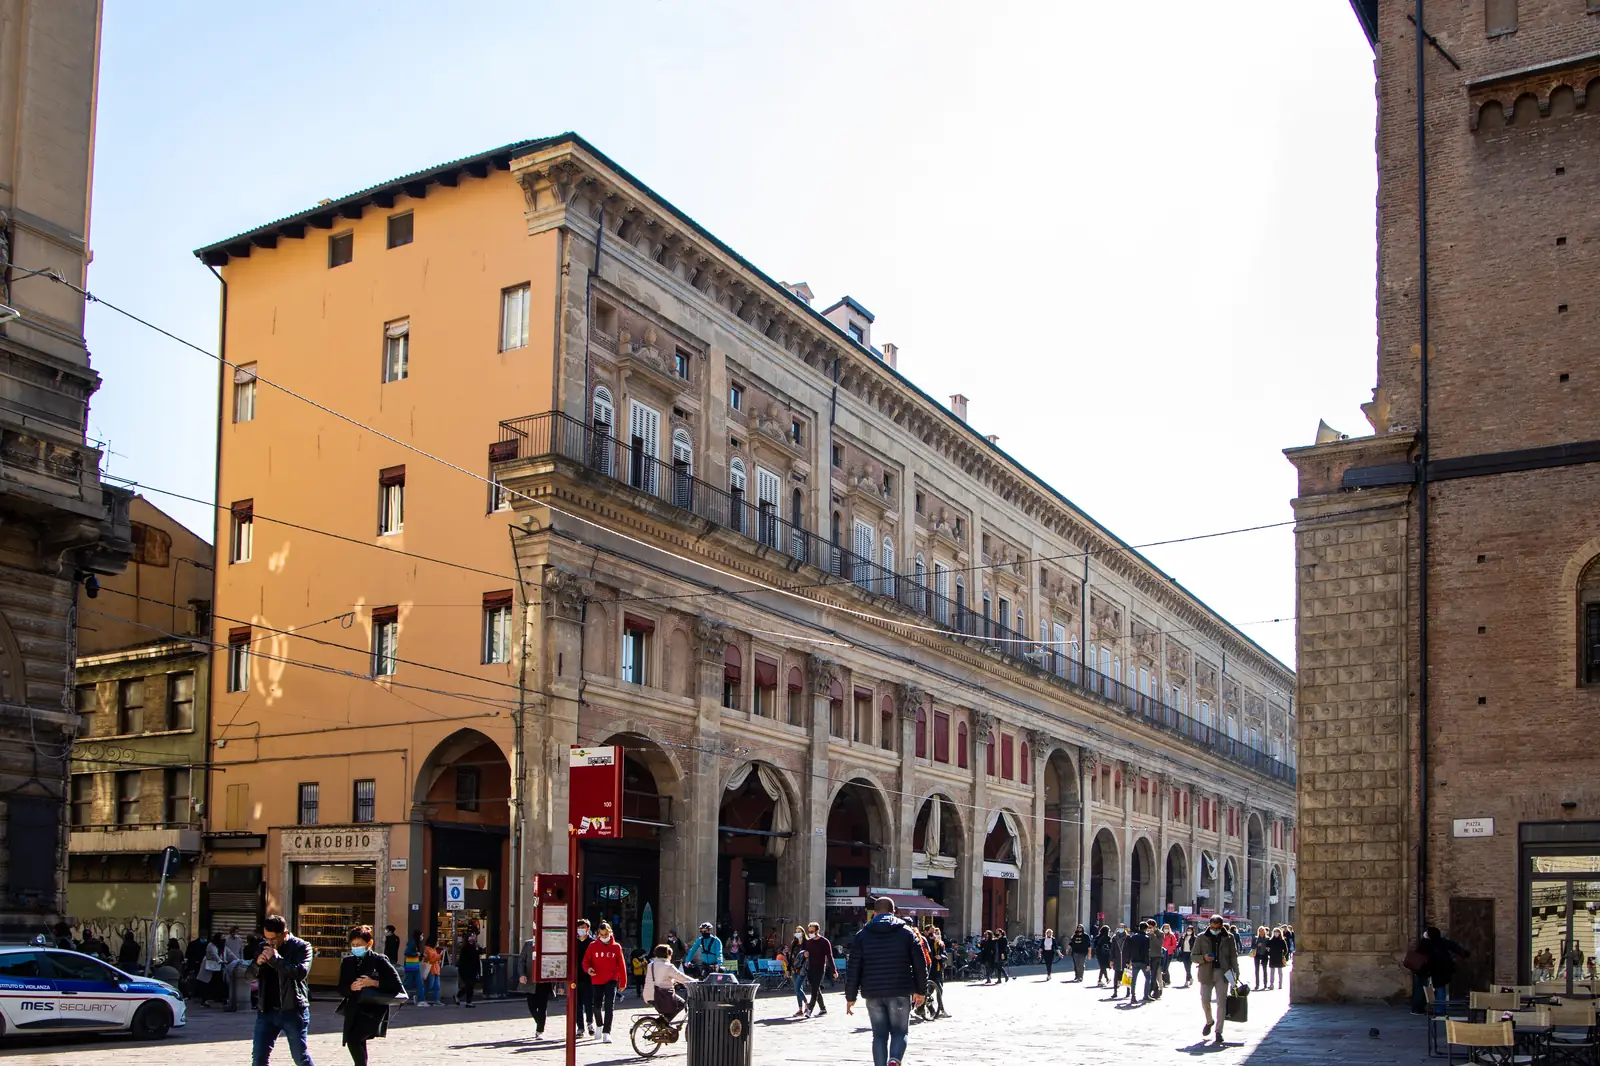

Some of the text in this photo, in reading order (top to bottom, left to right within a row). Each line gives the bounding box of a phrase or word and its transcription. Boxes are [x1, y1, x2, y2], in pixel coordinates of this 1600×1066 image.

[294, 835, 370, 849] CAROBBIO
[595, 951, 616, 959] OBEY
[21, 1001, 117, 1012] MES SECURITY
